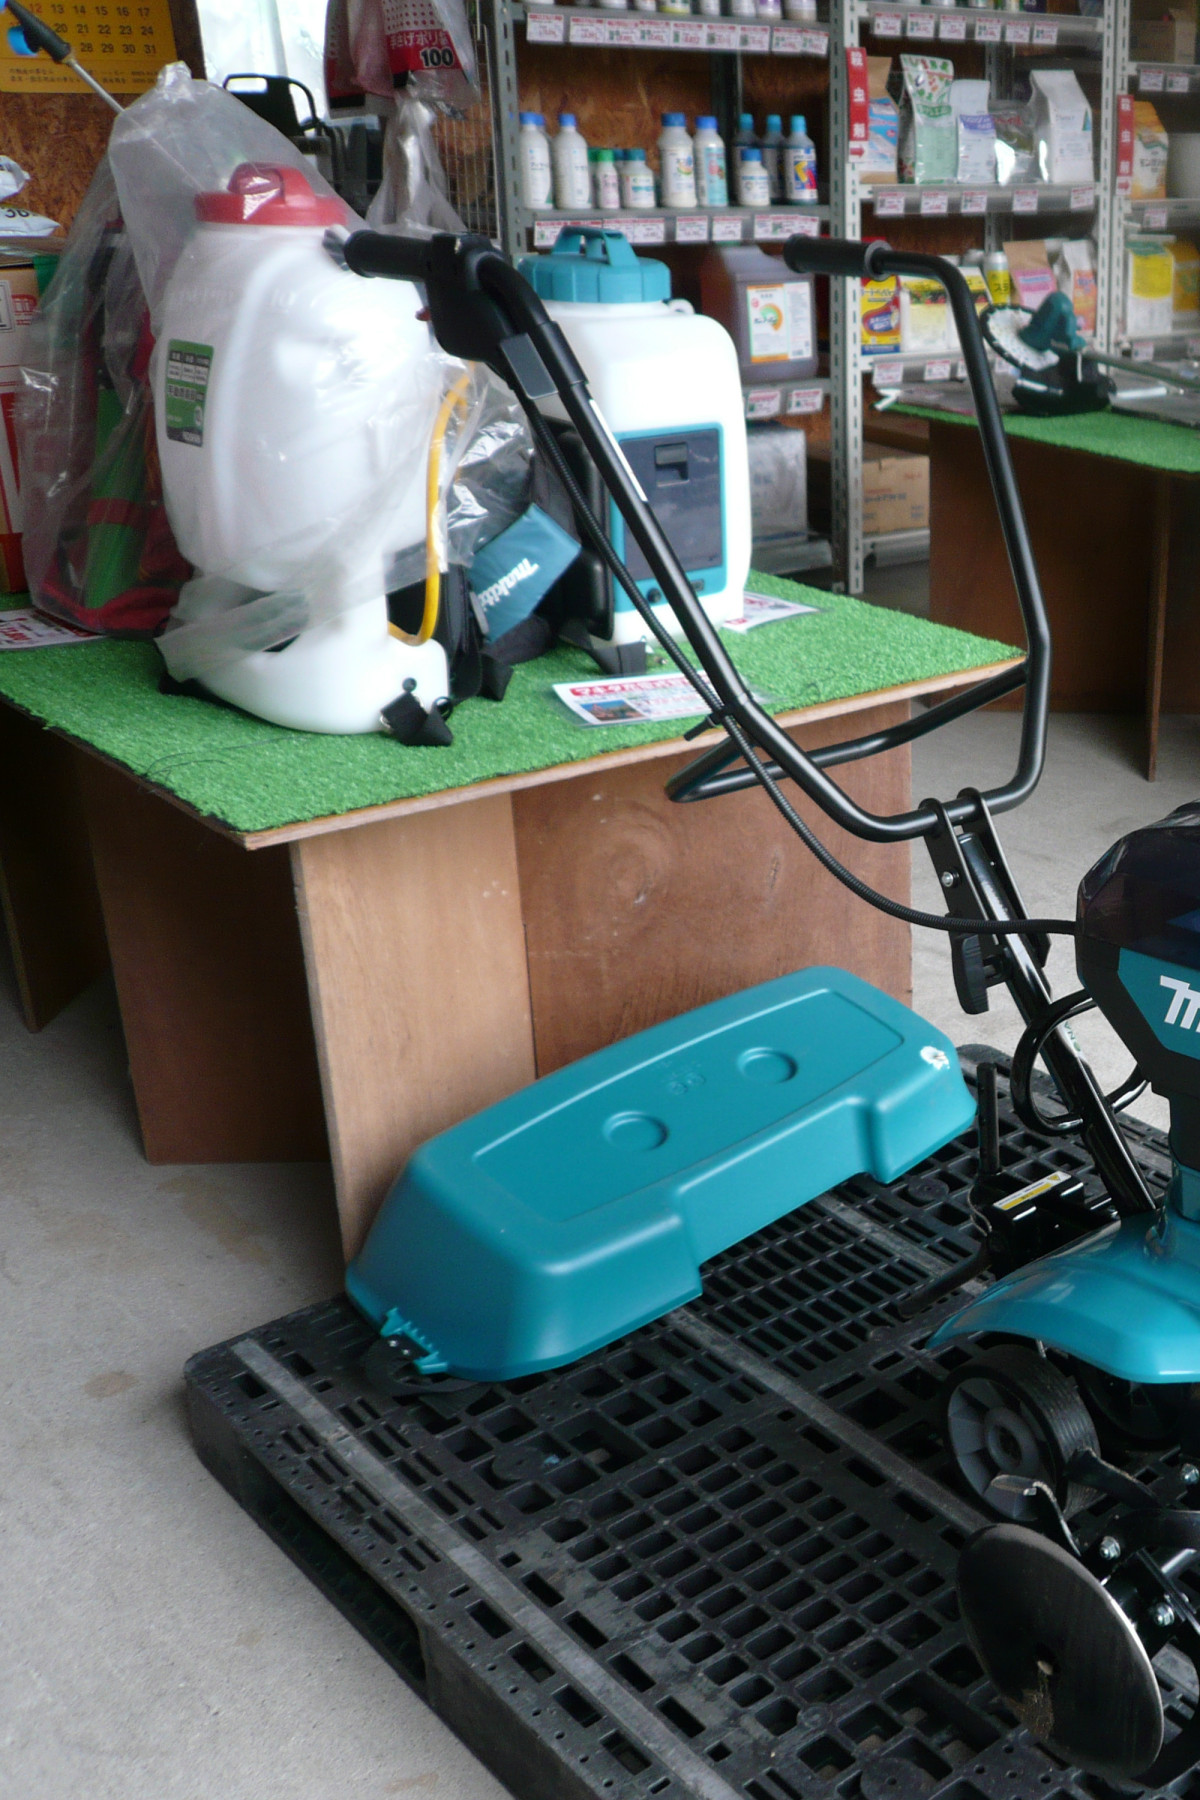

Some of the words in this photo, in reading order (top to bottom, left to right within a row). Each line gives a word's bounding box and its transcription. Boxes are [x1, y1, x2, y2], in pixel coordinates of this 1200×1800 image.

[51, 4, 64, 14] 13
[73, 5, 86, 15] 14
[95, 6, 108, 16] 15
[116, 7, 129, 17] 16
[138, 7, 150, 17] 17
[54, 23, 68, 33] 20
[77, 24, 89, 34] 21
[98, 25, 111, 35] 22
[119, 25, 133, 35] 23
[140, 25, 154, 36] 24
[80, 43, 93, 53] 28
[101, 43, 114, 53] 29
[122, 44, 136, 54] 30
[144, 44, 156, 54] 31
[420, 47, 455, 68] 100
